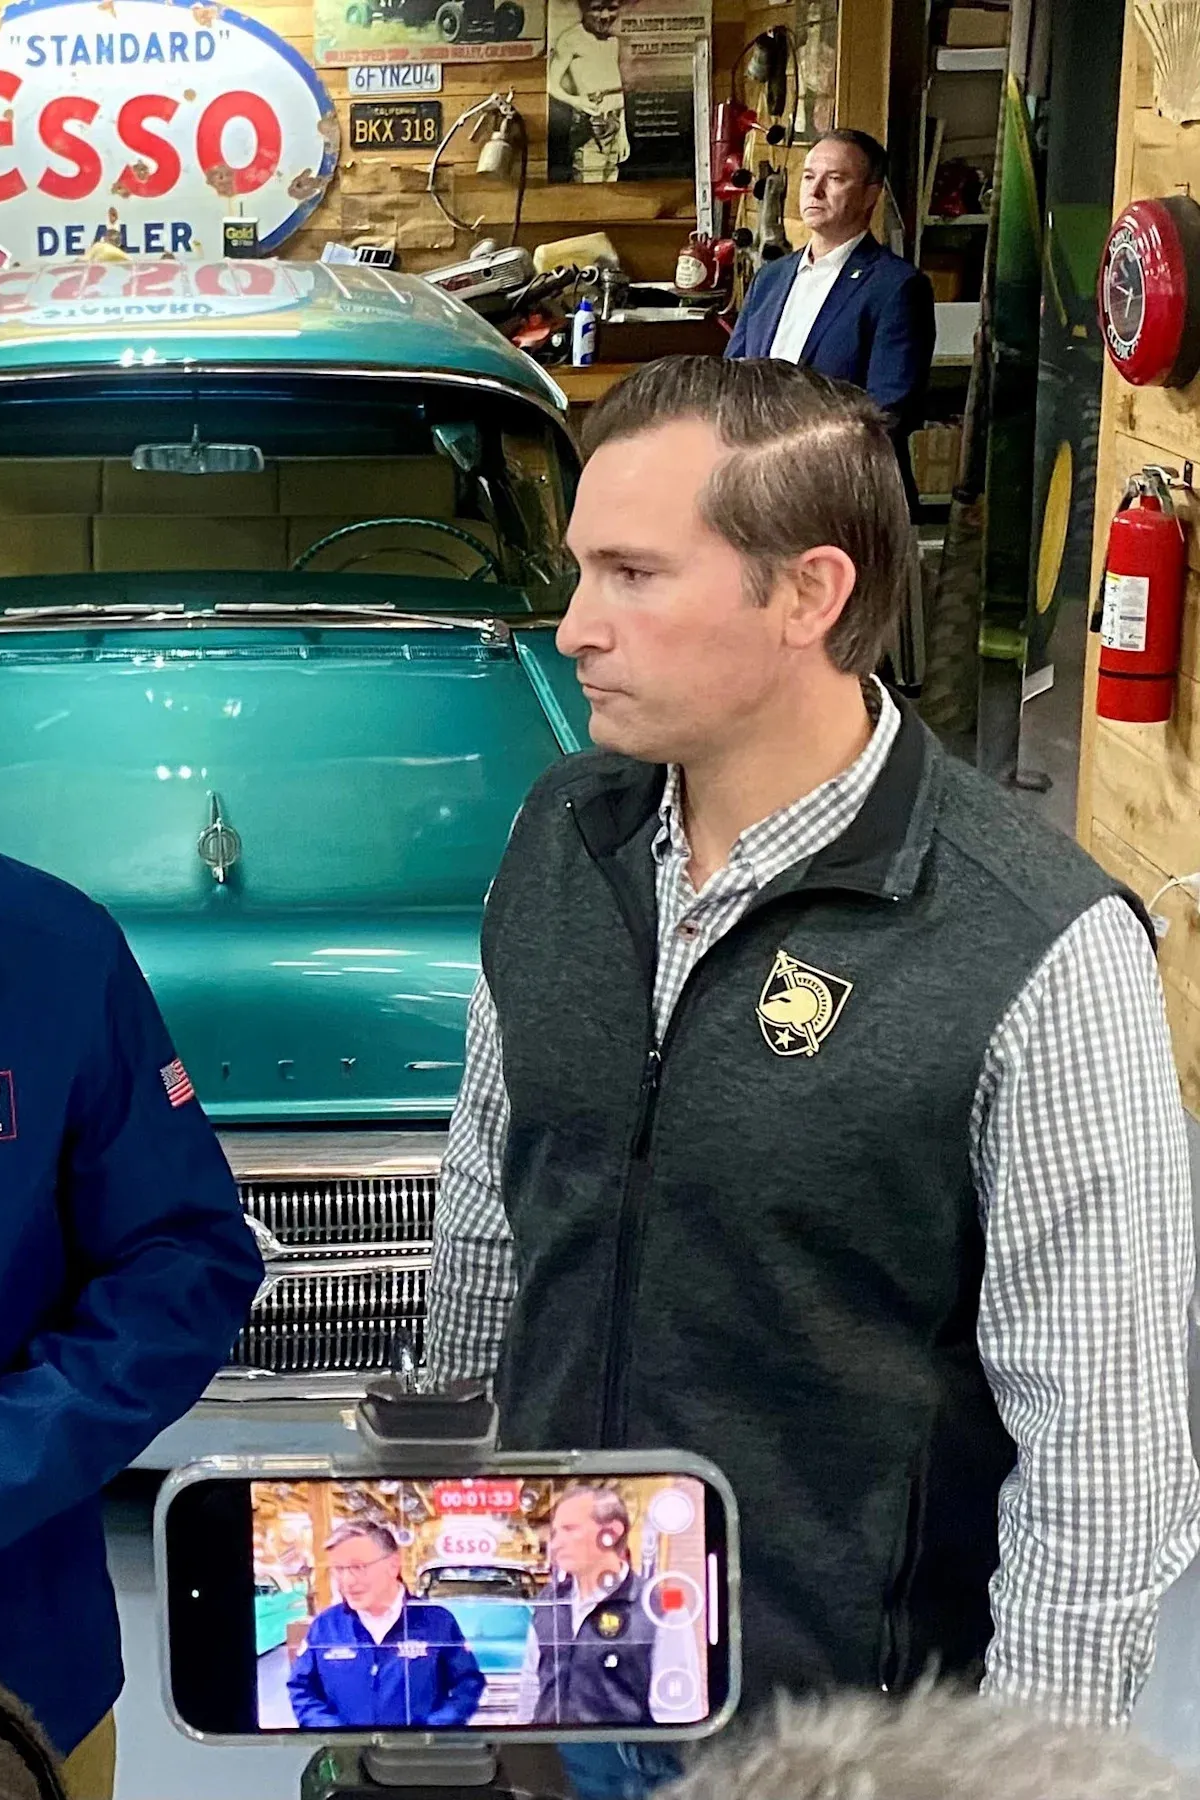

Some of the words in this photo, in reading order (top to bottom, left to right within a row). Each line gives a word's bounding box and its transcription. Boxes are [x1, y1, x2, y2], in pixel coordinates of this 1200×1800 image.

[355, 64, 435, 88] 6FYN204
[355, 119, 395, 143] BKX
[401, 118, 436, 143] 318
